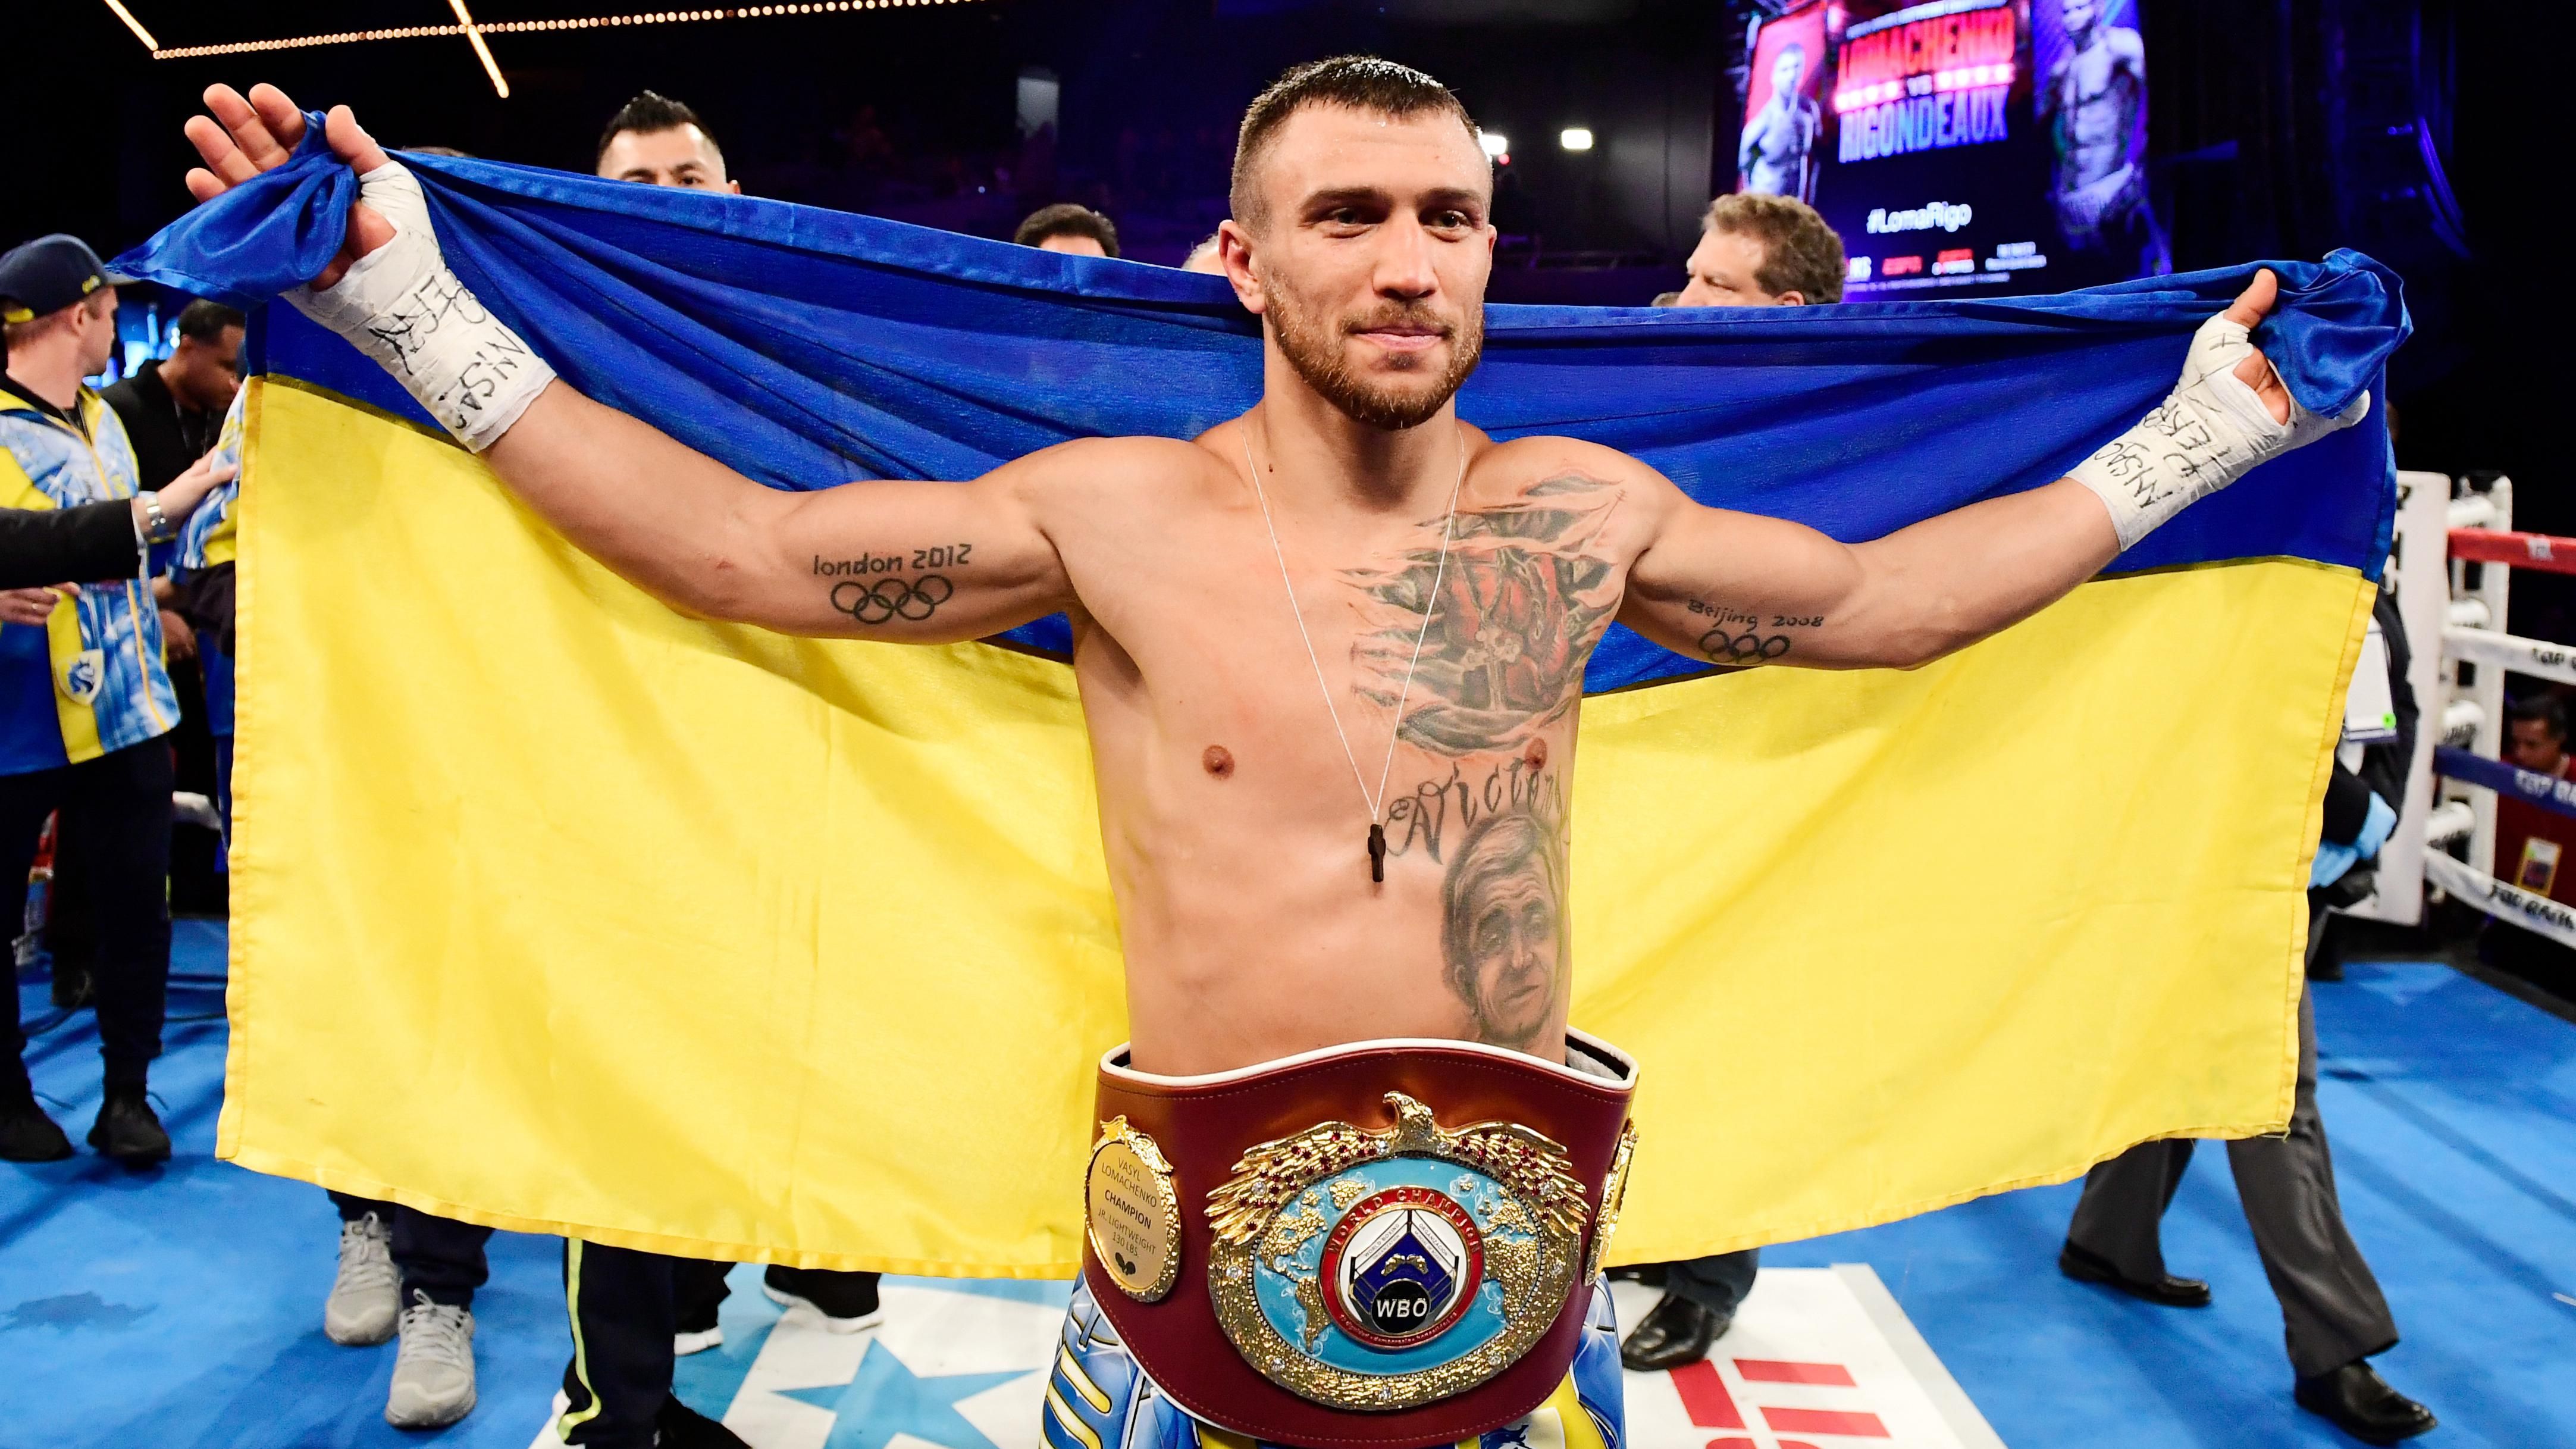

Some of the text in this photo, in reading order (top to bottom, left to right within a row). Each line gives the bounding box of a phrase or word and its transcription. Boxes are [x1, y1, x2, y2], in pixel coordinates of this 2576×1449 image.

[1839, 85, 2010, 164] RIGONDEAUX
[1866, 201, 1973, 234] #LomaRigo
[813, 543, 973, 576] london 2012
[1687, 599, 1825, 633] Beijing 2008
[1101, 1162, 1157, 1208] LOMACHENKO
[1118, 1157, 1140, 1182] VASYL
[1105, 1190, 1152, 1230] CHAMPION
[1327, 1190, 1481, 1253] WORLD CHAMPION
[1098, 1207, 1156, 1255] JR. LIGHTWEIGHT
[1112, 1231, 1139, 1258] 130 LBS.
[1364, 1223, 1400, 1257] WORLD BOXING
[1376, 1298, 1428, 1318] WBO
